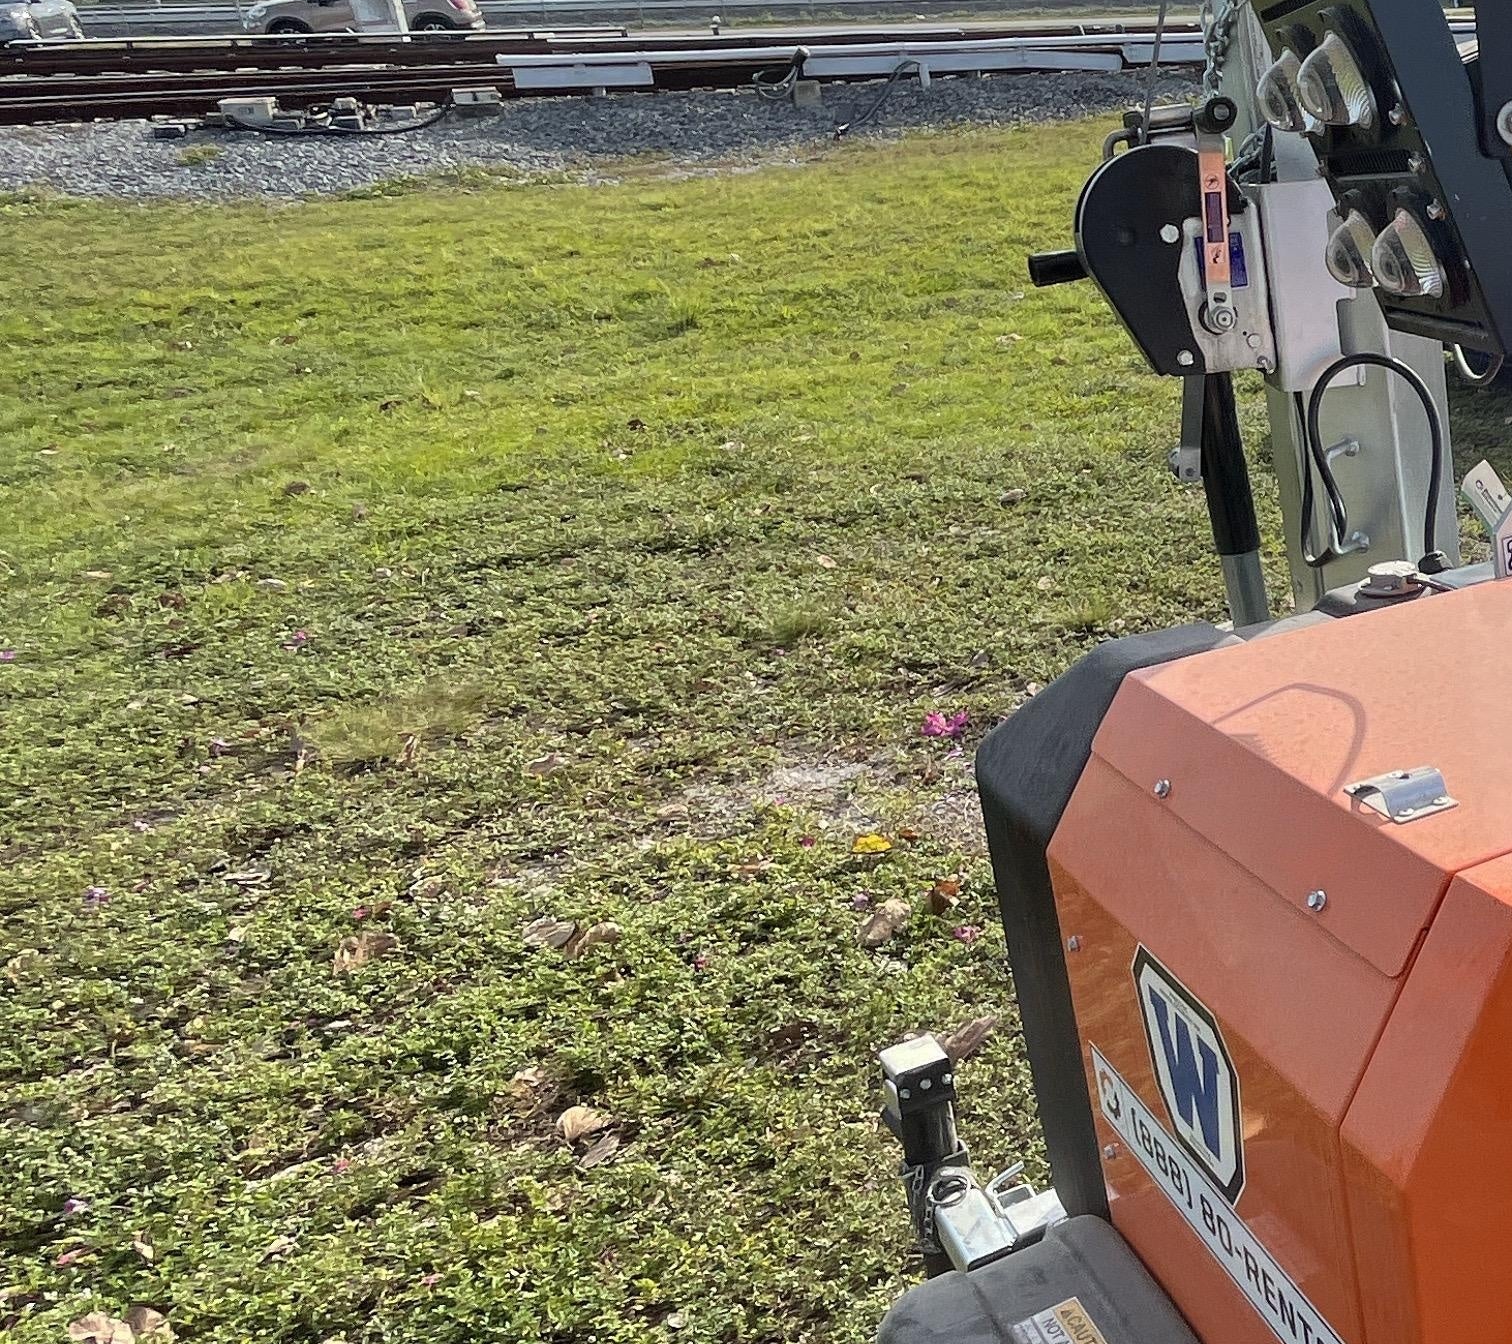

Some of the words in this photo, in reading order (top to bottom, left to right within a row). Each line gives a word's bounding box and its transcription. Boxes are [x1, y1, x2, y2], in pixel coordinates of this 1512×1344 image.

[1148, 983, 1221, 1162] W
[1130, 1106, 1194, 1210] (888)
[1042, 1317, 1065, 1339] NOT
